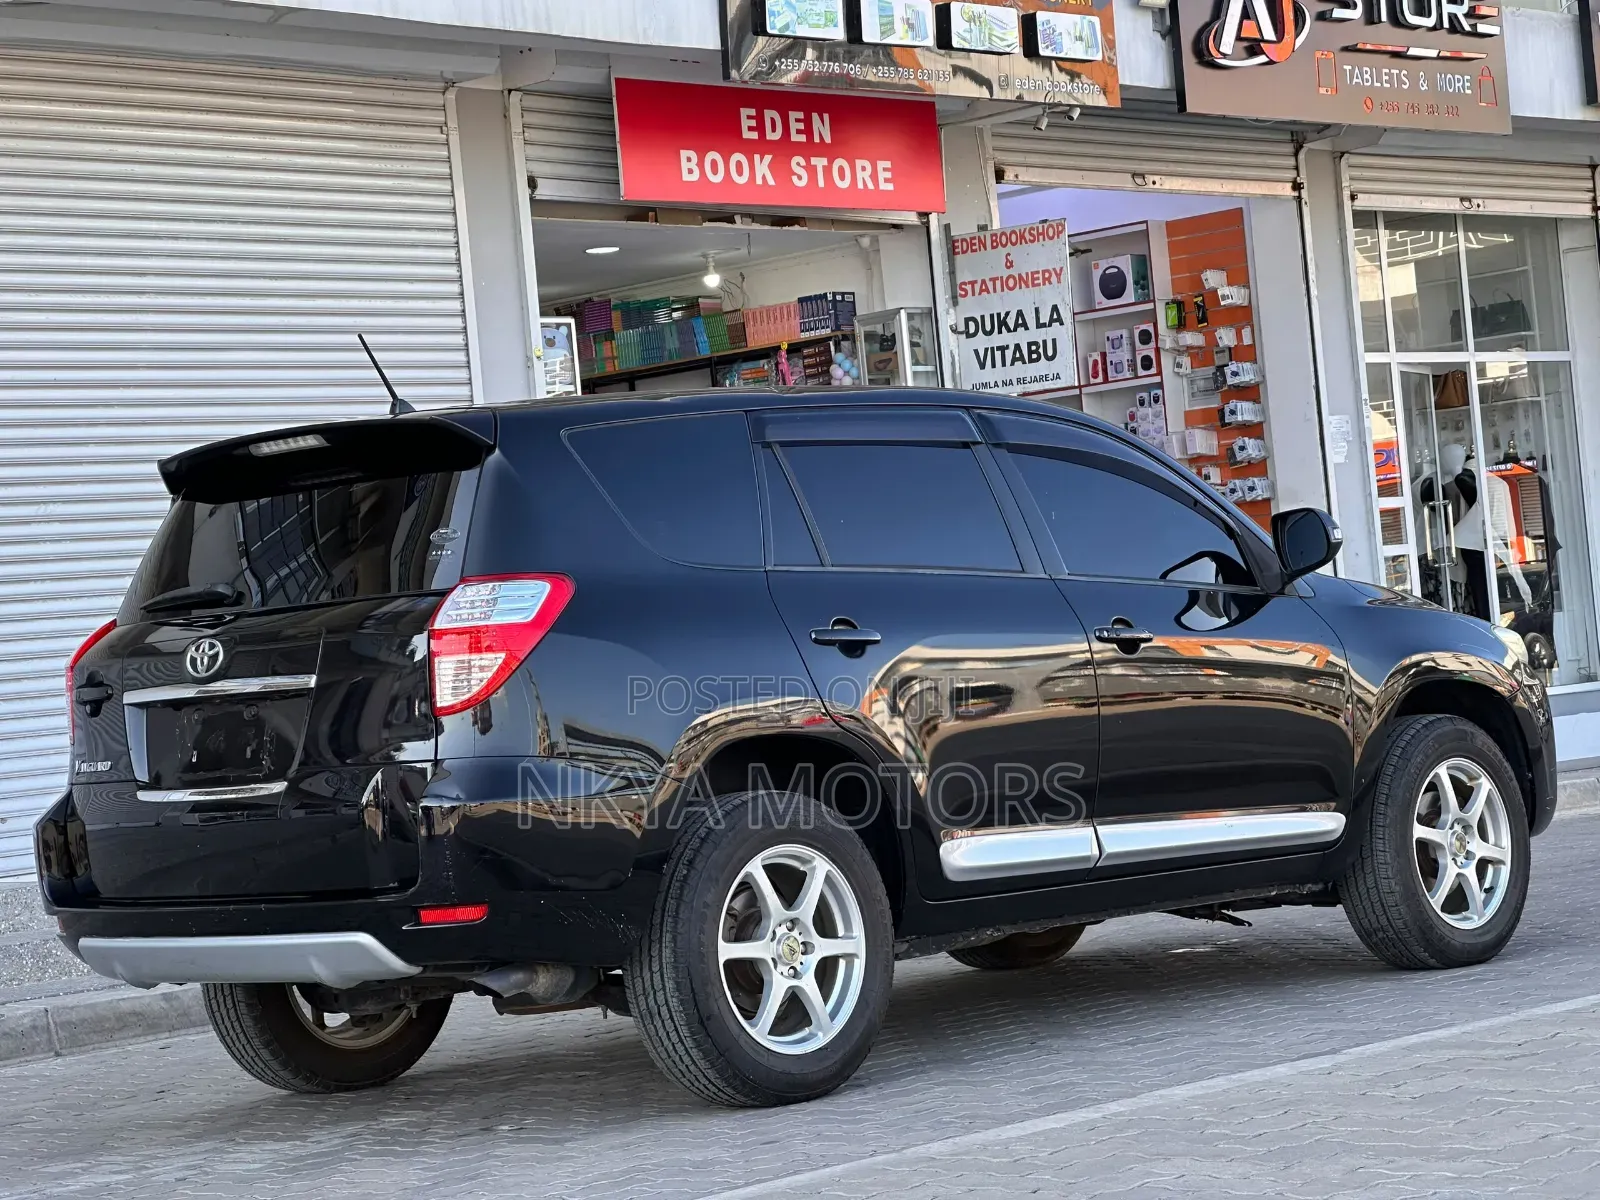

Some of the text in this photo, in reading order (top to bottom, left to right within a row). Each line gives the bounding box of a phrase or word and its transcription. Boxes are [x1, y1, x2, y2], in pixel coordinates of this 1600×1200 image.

[775, 58, 799, 69] +255
[822, 61, 840, 73] 776
[843, 63, 862, 75] 706
[872, 66, 896, 78] +255
[898, 67, 915, 80] 785
[917, 69, 934, 81] 621
[935, 70, 950, 82] 155
[1015, 76, 1100, 95] eden.bookstore
[1343, 65, 1473, 94] TABLETS & MORE
[740, 107, 832, 144] EDEN
[679, 149, 894, 191] BOOK STORE
[952, 222, 1065, 256] EDEN BOOKSHOP
[1005, 252, 1014, 270] &
[958, 266, 1064, 298] STATIONERY
[963, 304, 1064, 339] DUKA LA
[973, 338, 1058, 370] VITABU
[971, 372, 1061, 391] JUMLA NA REJAREJA
